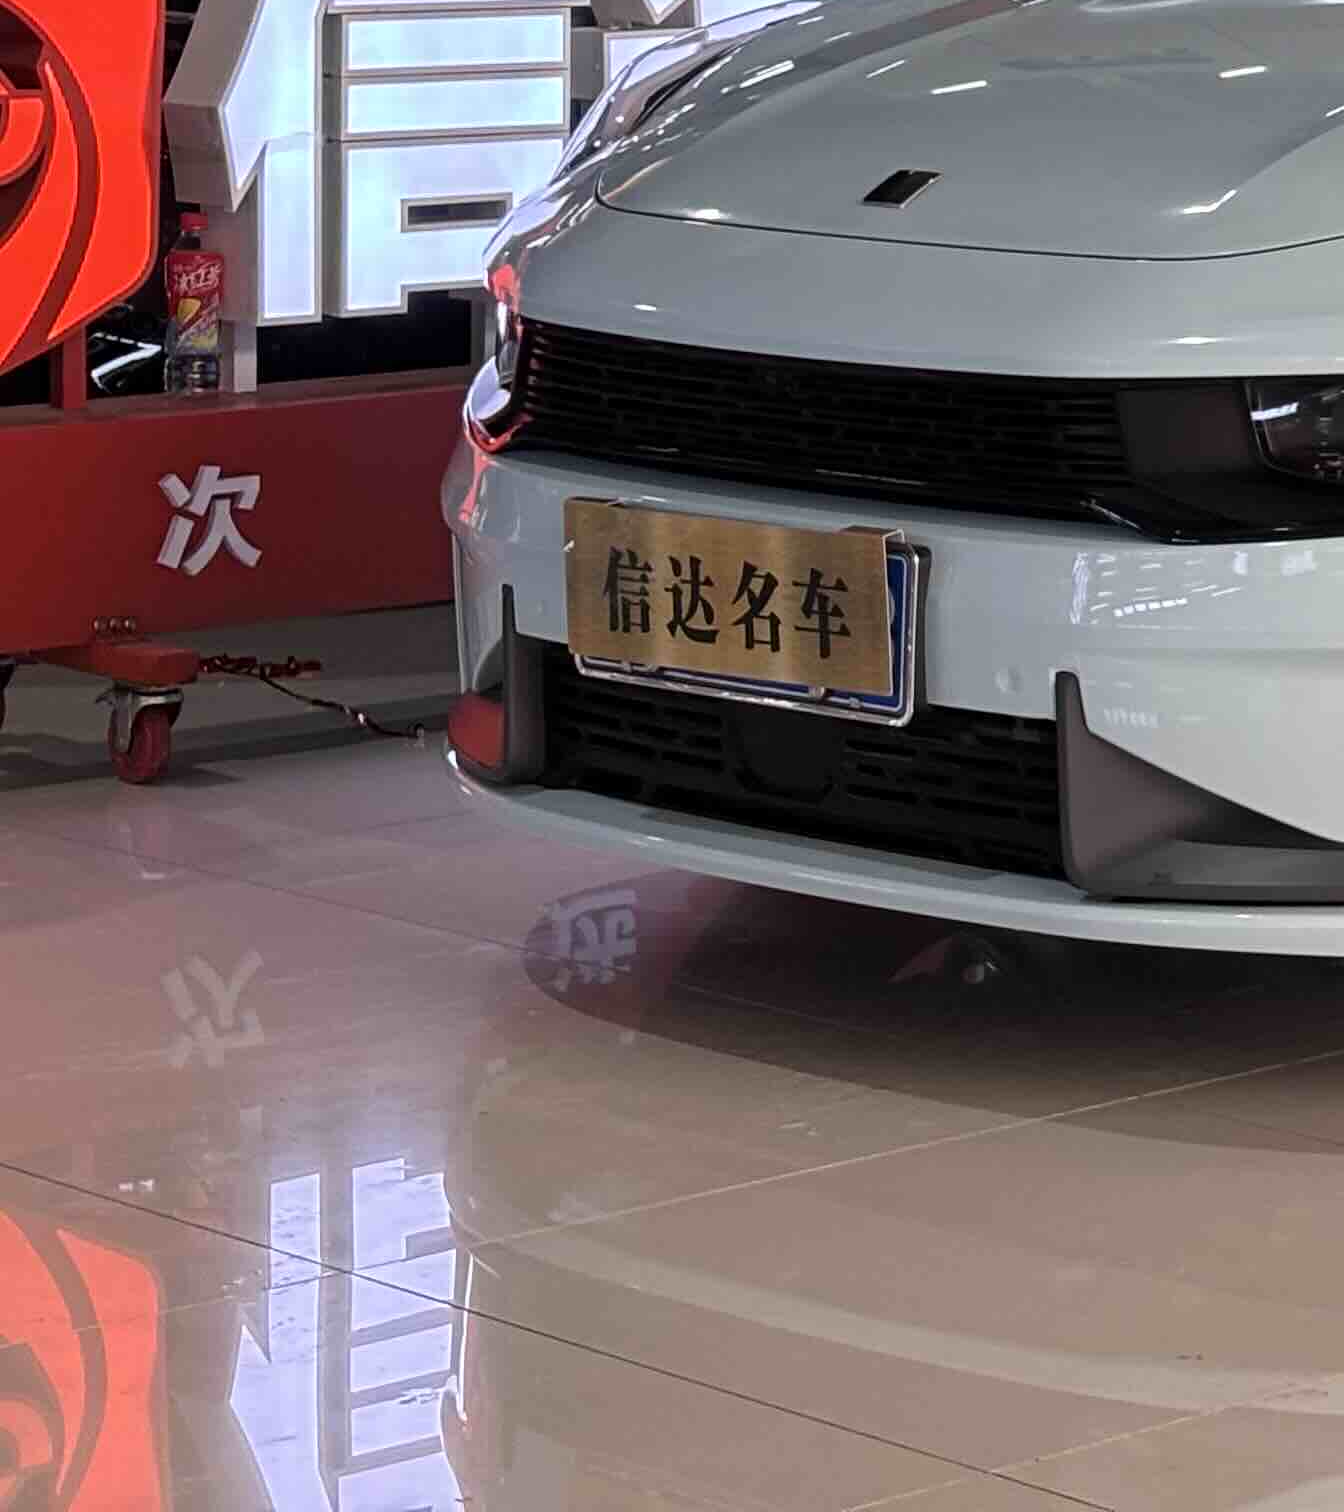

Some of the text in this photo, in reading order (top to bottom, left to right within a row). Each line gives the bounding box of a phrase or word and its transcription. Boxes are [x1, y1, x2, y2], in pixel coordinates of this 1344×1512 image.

[157, 465, 262, 574] 次
[603, 545, 851, 660] 信达名车
